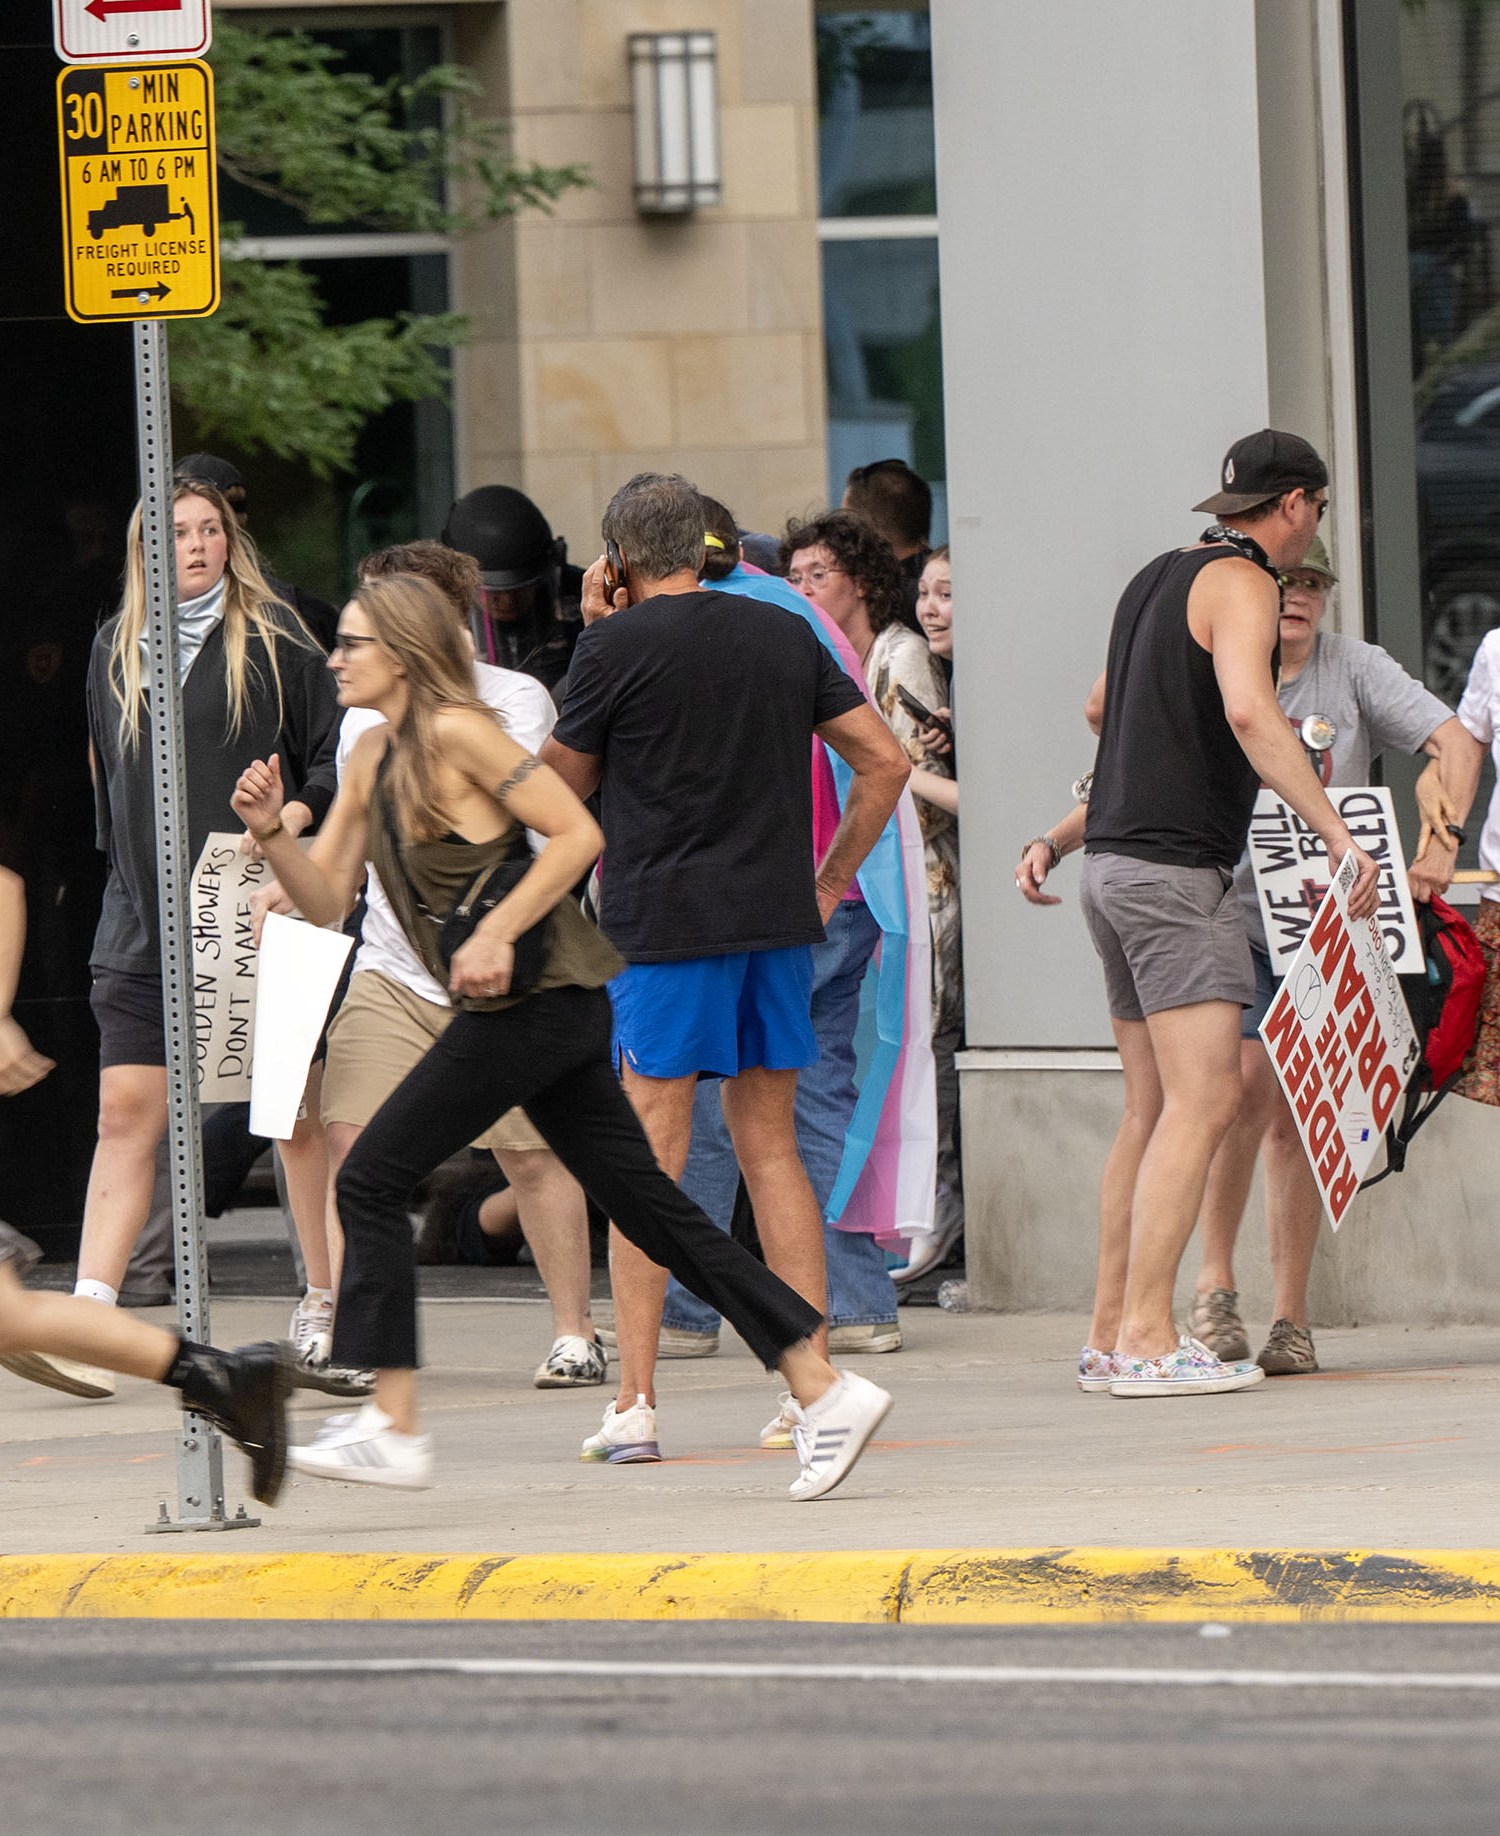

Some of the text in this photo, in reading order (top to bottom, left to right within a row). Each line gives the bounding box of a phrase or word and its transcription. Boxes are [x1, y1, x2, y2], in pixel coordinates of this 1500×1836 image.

[65, 91, 105, 140] 30
[143, 73, 179, 104] MIN
[111, 110, 203, 144] PARKING
[82, 156, 195, 184] 6 AM TO 6 PM
[76, 239, 207, 260] FREIGHT LICENSE
[106, 260, 181, 277] REQUIRED
[192, 847, 236, 961] SHOWERS
[1251, 803, 1313, 955] WE WILL
[217, 992, 251, 1079] DON'T
[1310, 896, 1400, 1131] DREAM
[1316, 1013, 1351, 1110] THE
[1265, 991, 1356, 1220] REDEEM
